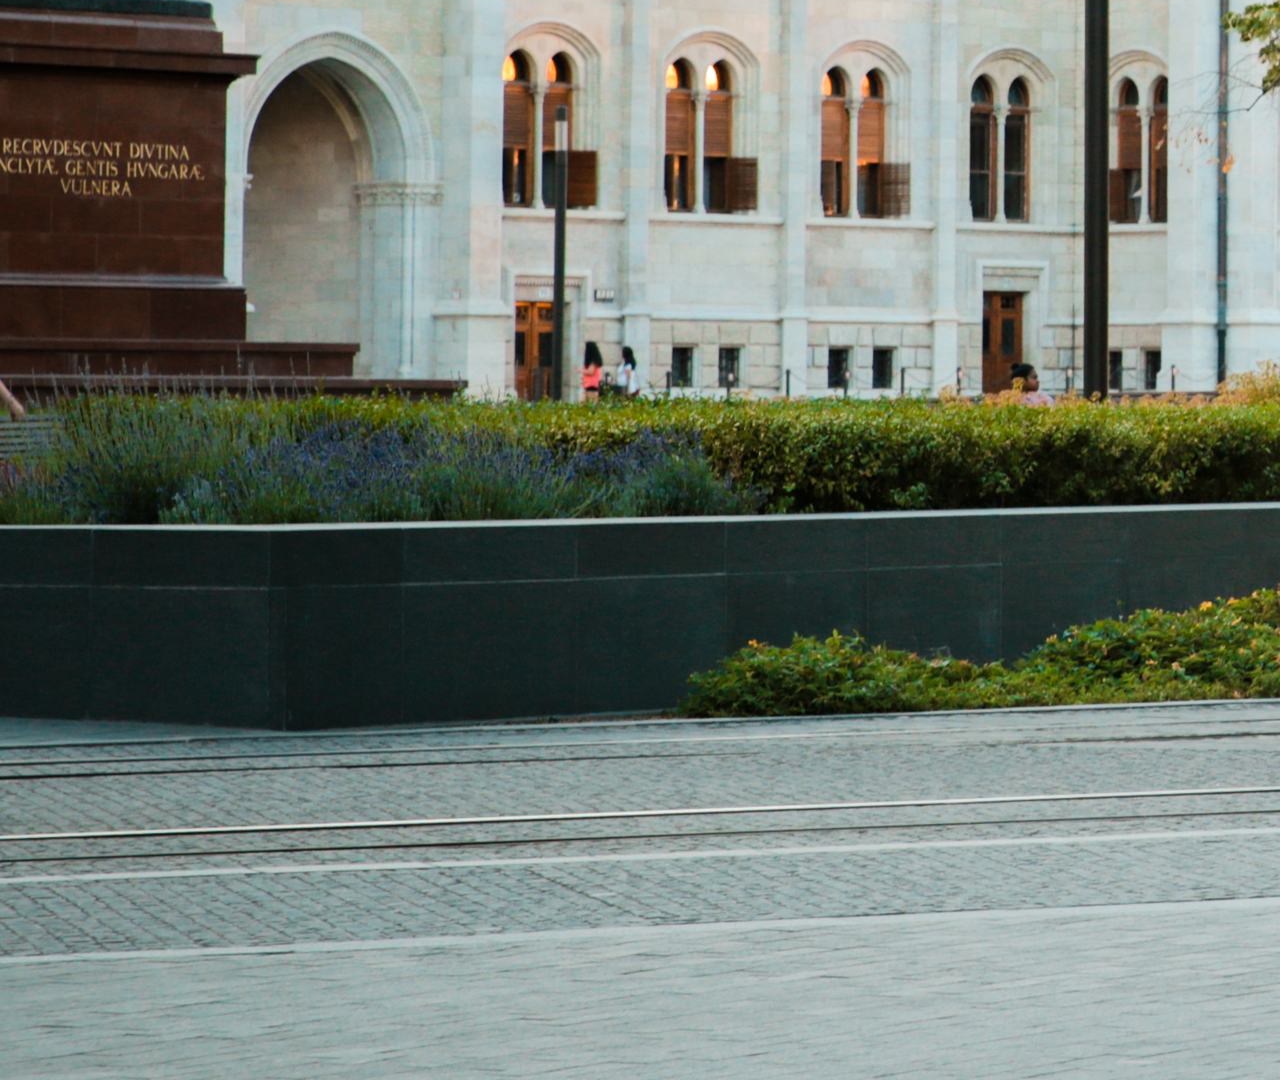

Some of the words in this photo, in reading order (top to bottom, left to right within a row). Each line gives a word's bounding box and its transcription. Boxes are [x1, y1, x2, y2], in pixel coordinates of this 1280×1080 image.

[2, 138, 122, 159] RECRVDESCVNT
[129, 142, 190, 161] DIVTINA
[65, 160, 118, 177] GENTIS
